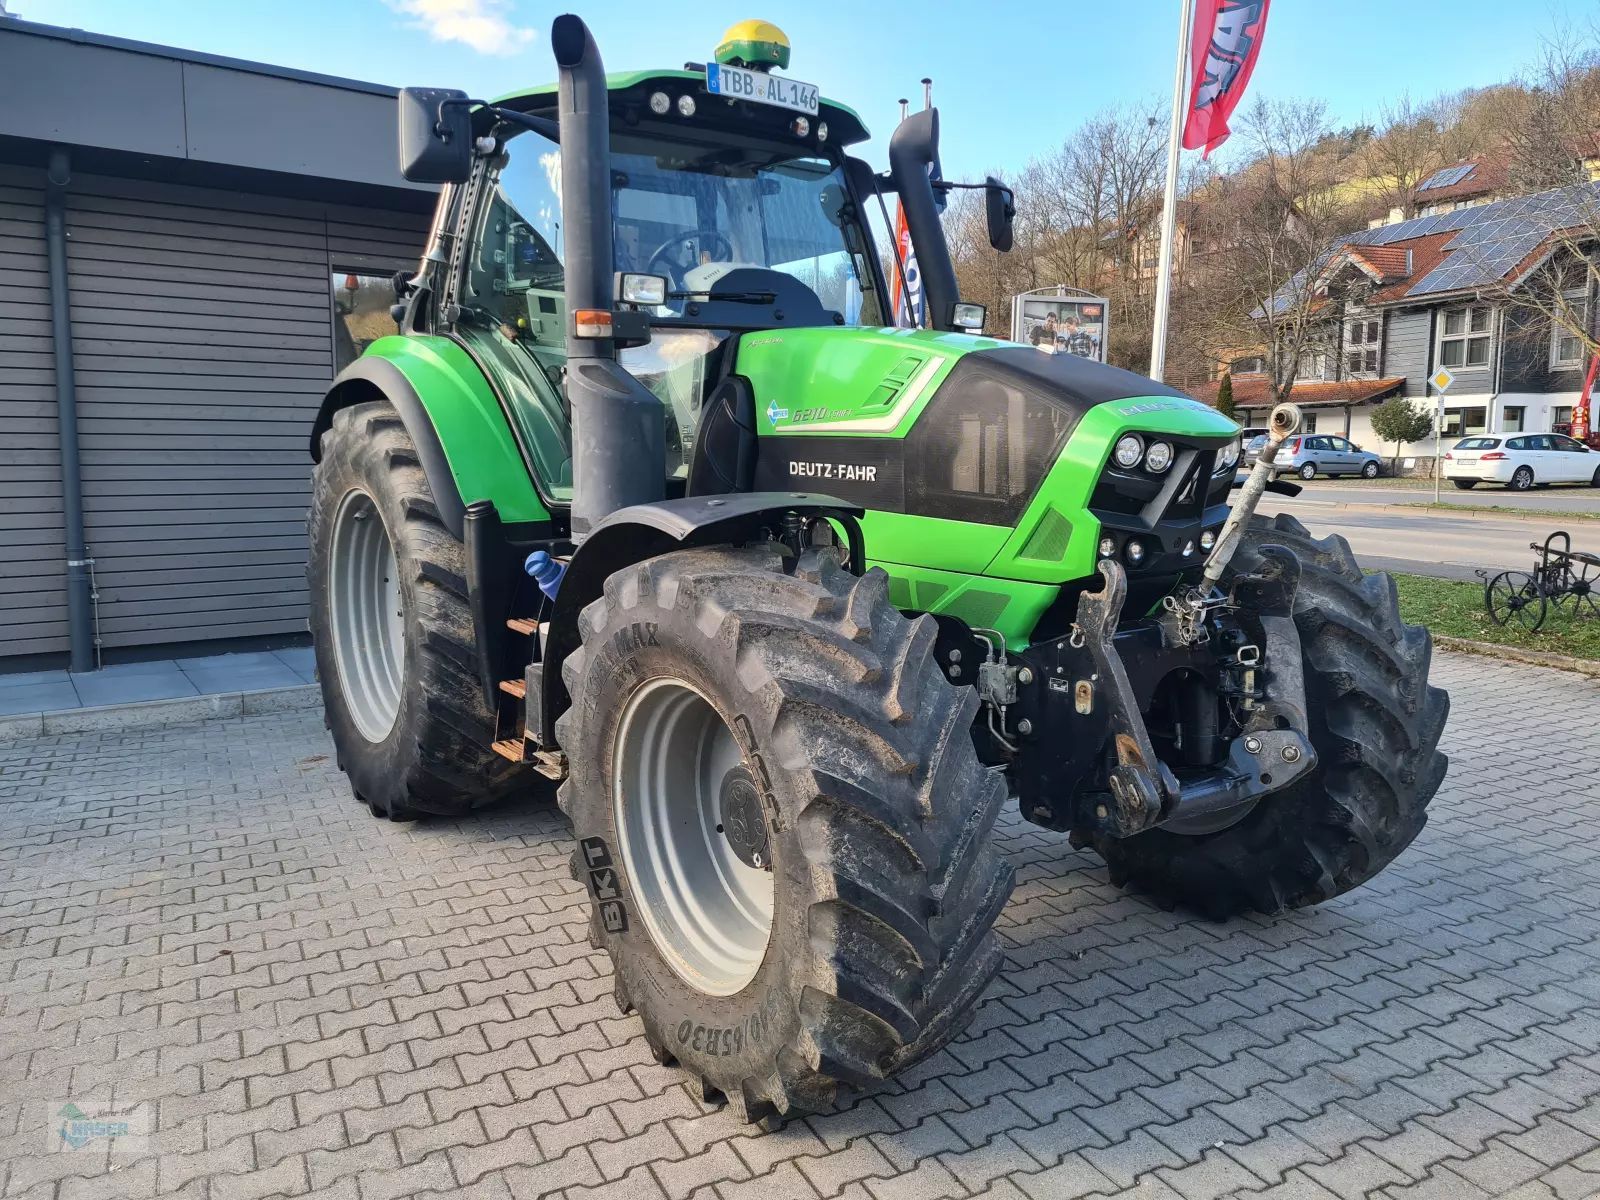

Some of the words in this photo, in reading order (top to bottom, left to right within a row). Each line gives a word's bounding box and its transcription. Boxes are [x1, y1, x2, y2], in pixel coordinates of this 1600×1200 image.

[721, 69, 754, 95] TBB
[767, 78, 787, 103] AL
[790, 84, 818, 110] 146
[792, 408, 828, 423] 6210
[581, 836, 628, 932] BKT
